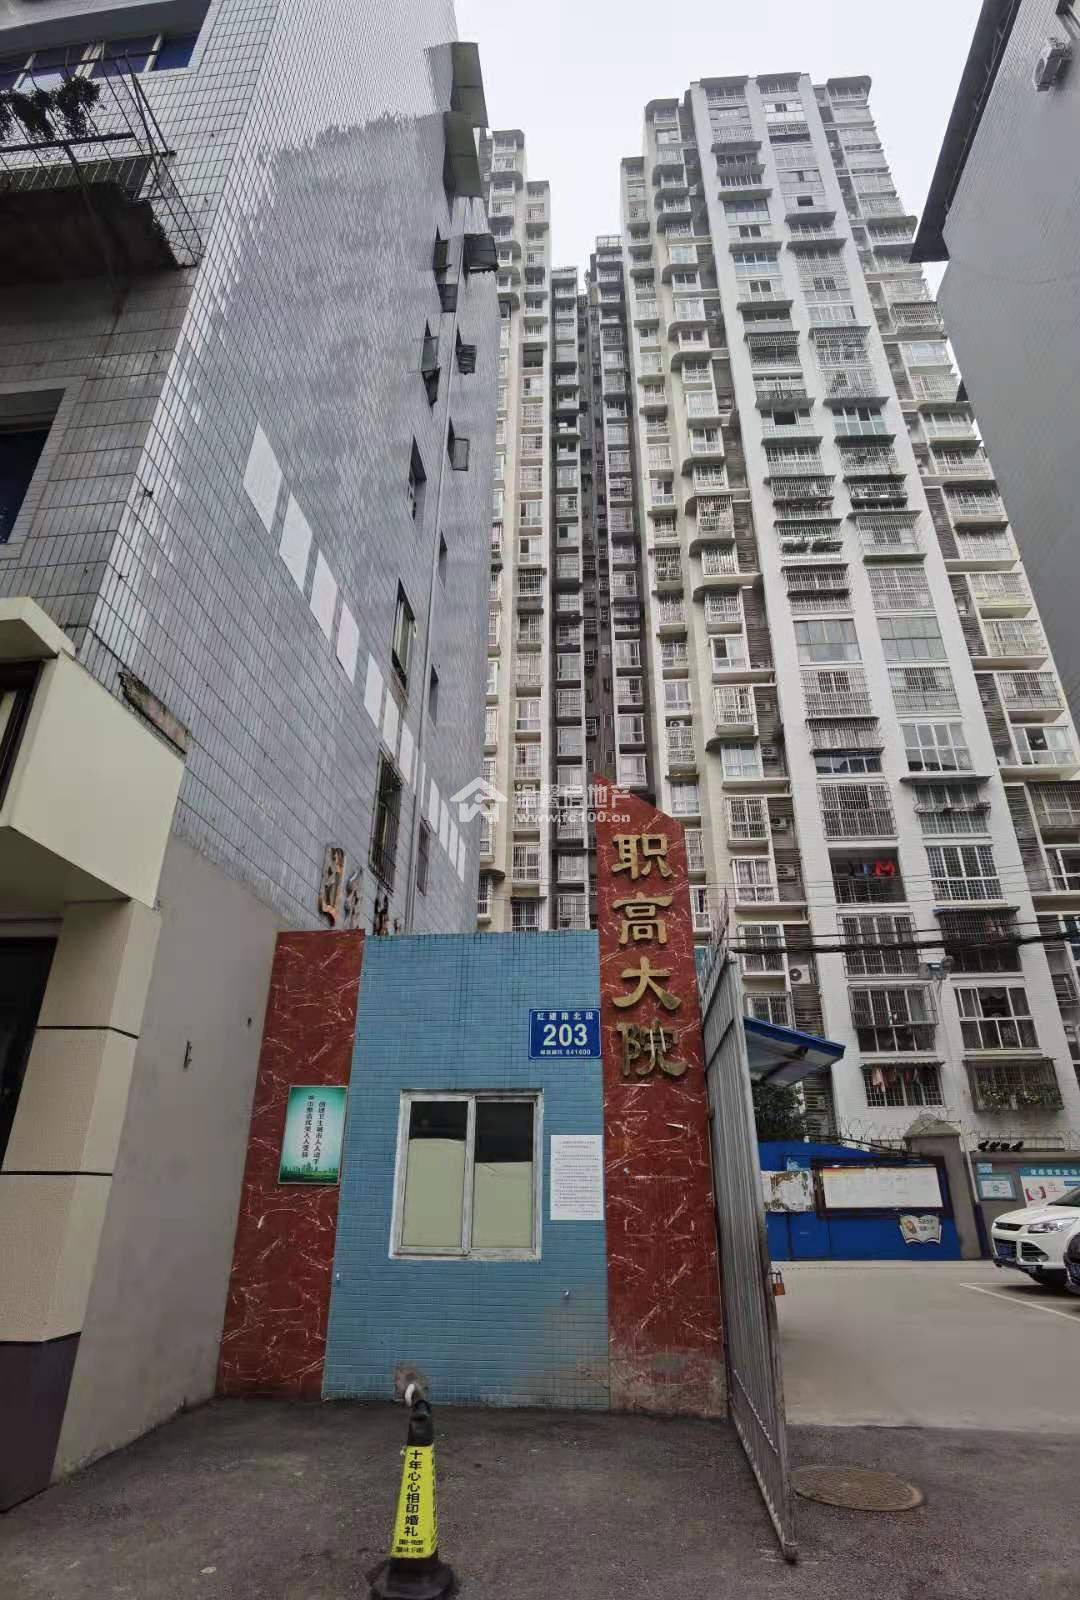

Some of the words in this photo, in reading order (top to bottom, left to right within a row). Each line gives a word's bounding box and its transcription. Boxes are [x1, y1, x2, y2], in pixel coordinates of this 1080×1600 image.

[611, 834, 689, 1077] 职高大院
[543, 1023, 588, 1047] 203
[403, 1449, 423, 1537] 十年心心相印婚礼
